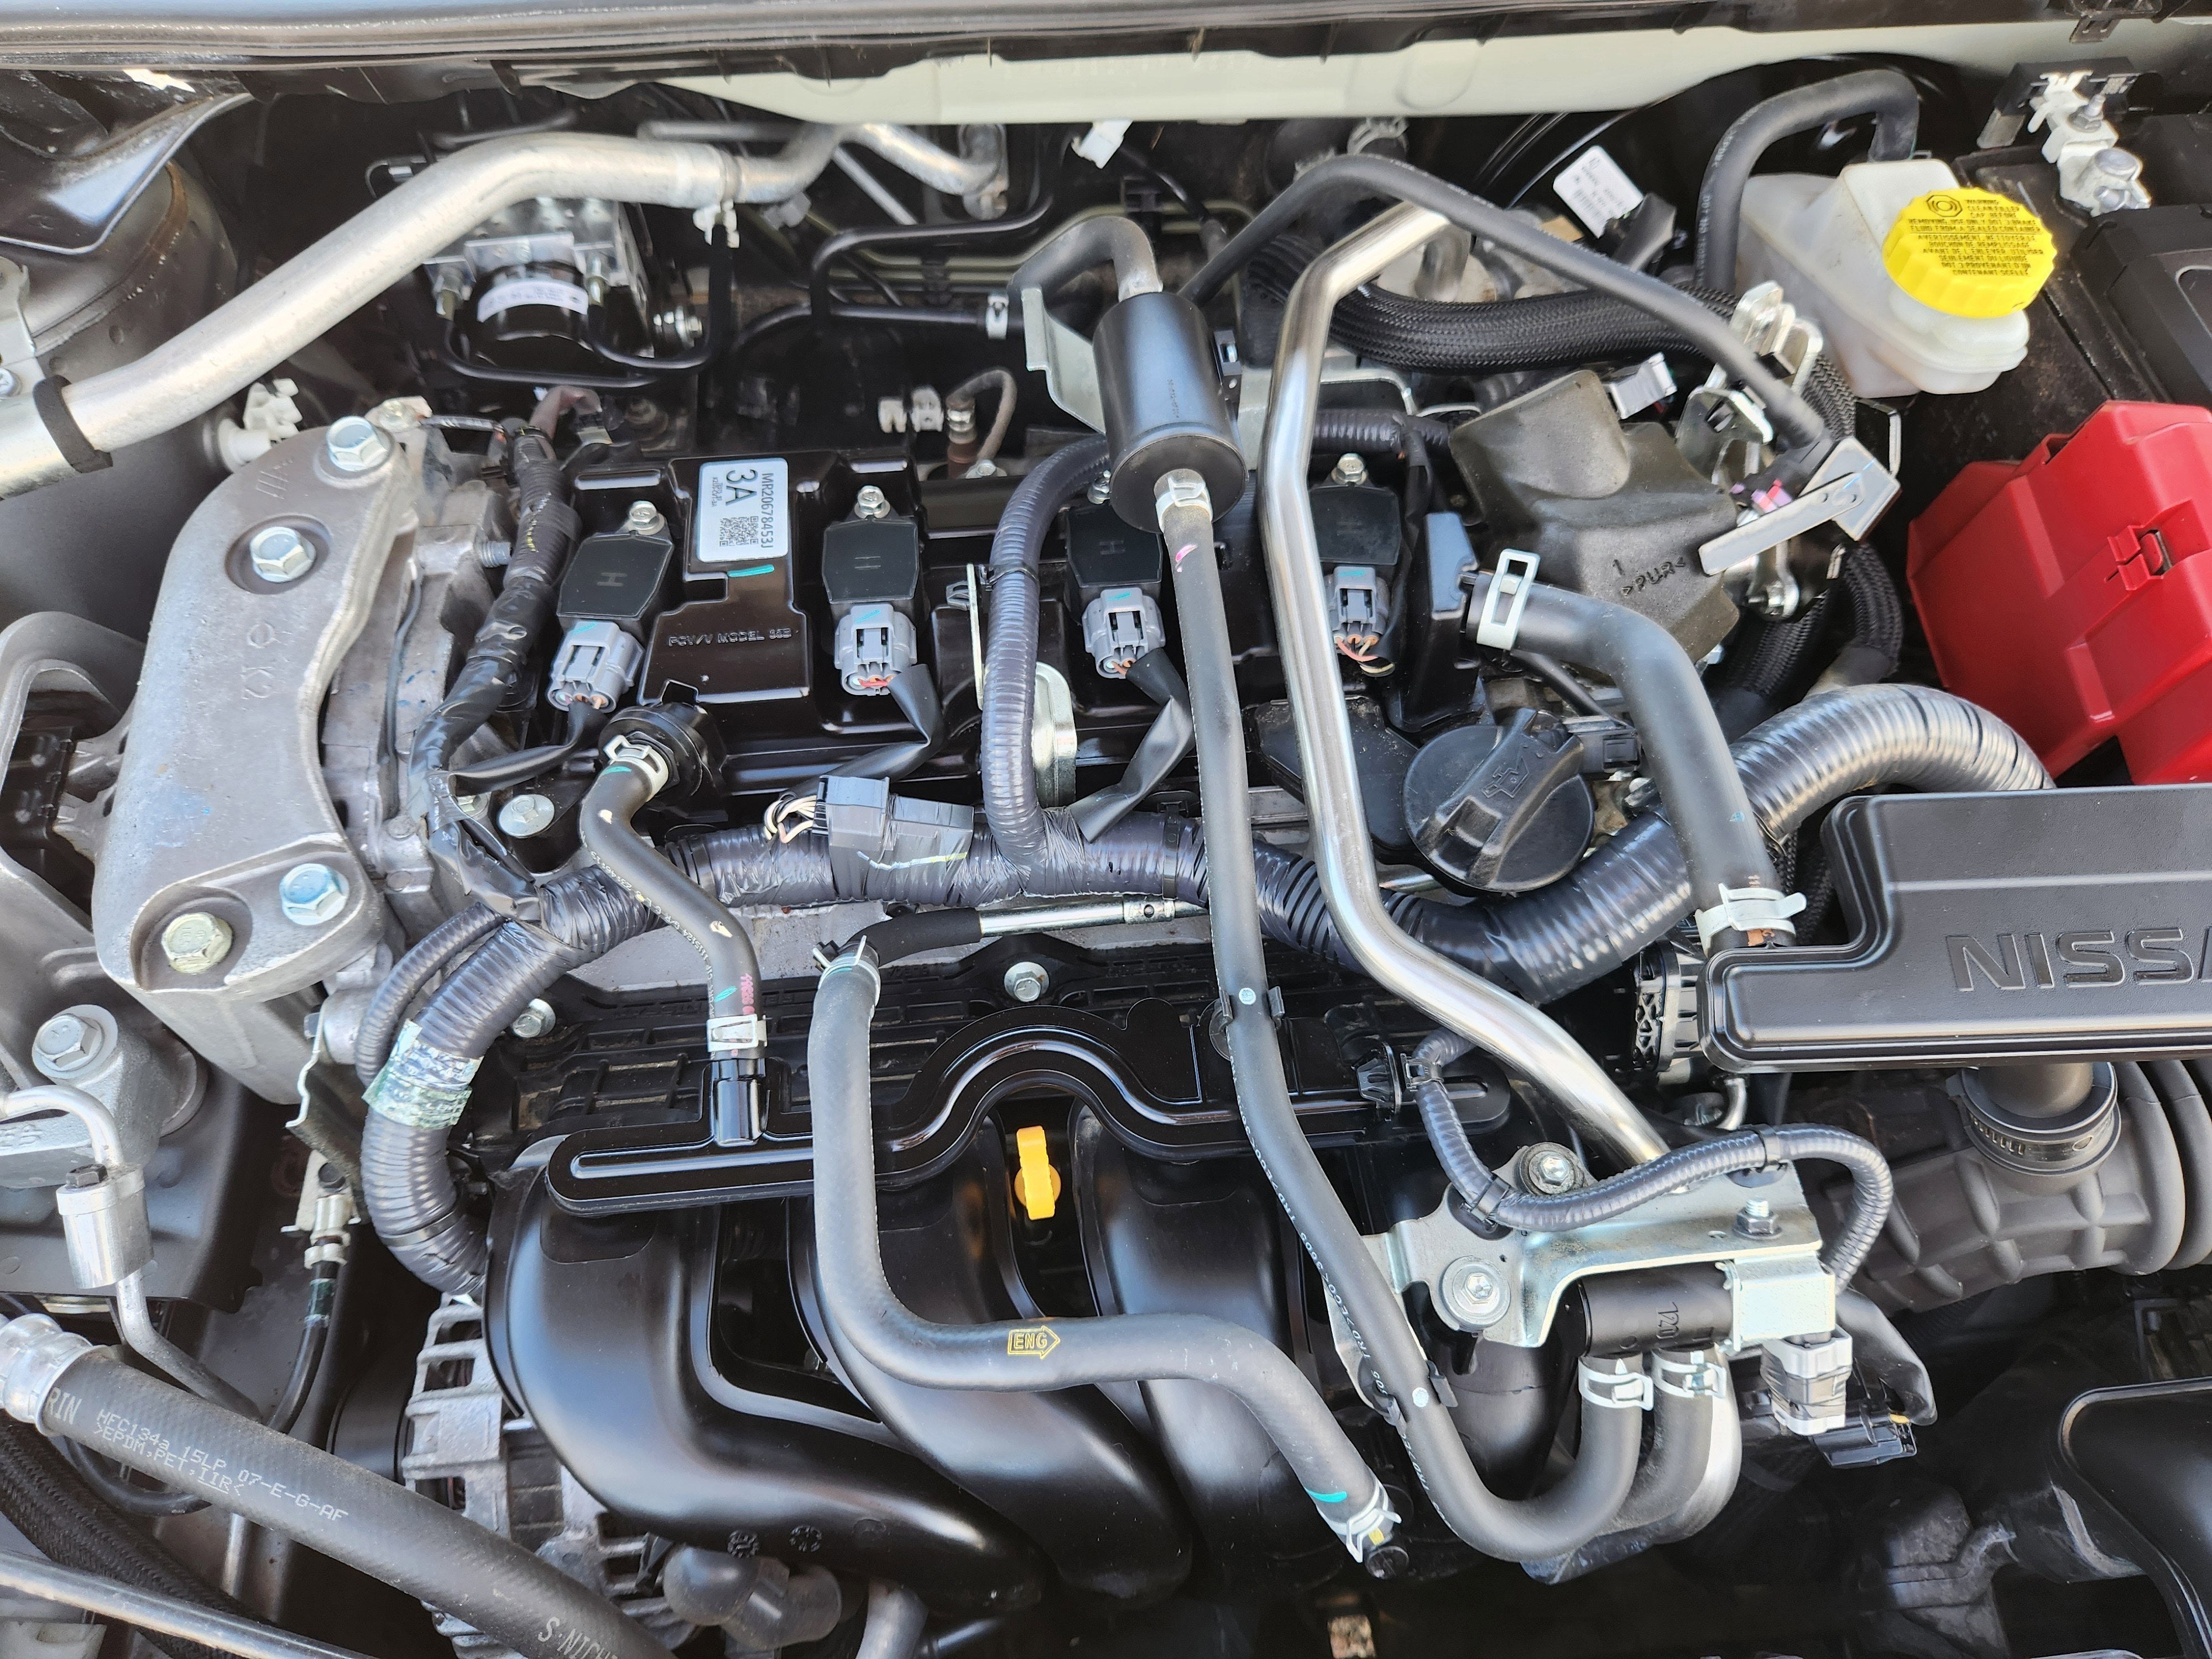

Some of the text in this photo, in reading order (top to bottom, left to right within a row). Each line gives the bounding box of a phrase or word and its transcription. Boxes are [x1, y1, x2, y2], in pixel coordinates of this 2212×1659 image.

[725, 469, 758, 506] 3A
[760, 472, 774, 549] MR20678453J
[717, 629, 765, 644] MODEL
[1945, 926, 2212, 992] NISS
[1013, 1333, 1048, 1349] ENG
[96, 1408, 349, 1523] HFC134a 15LP 07-E-G-AF
